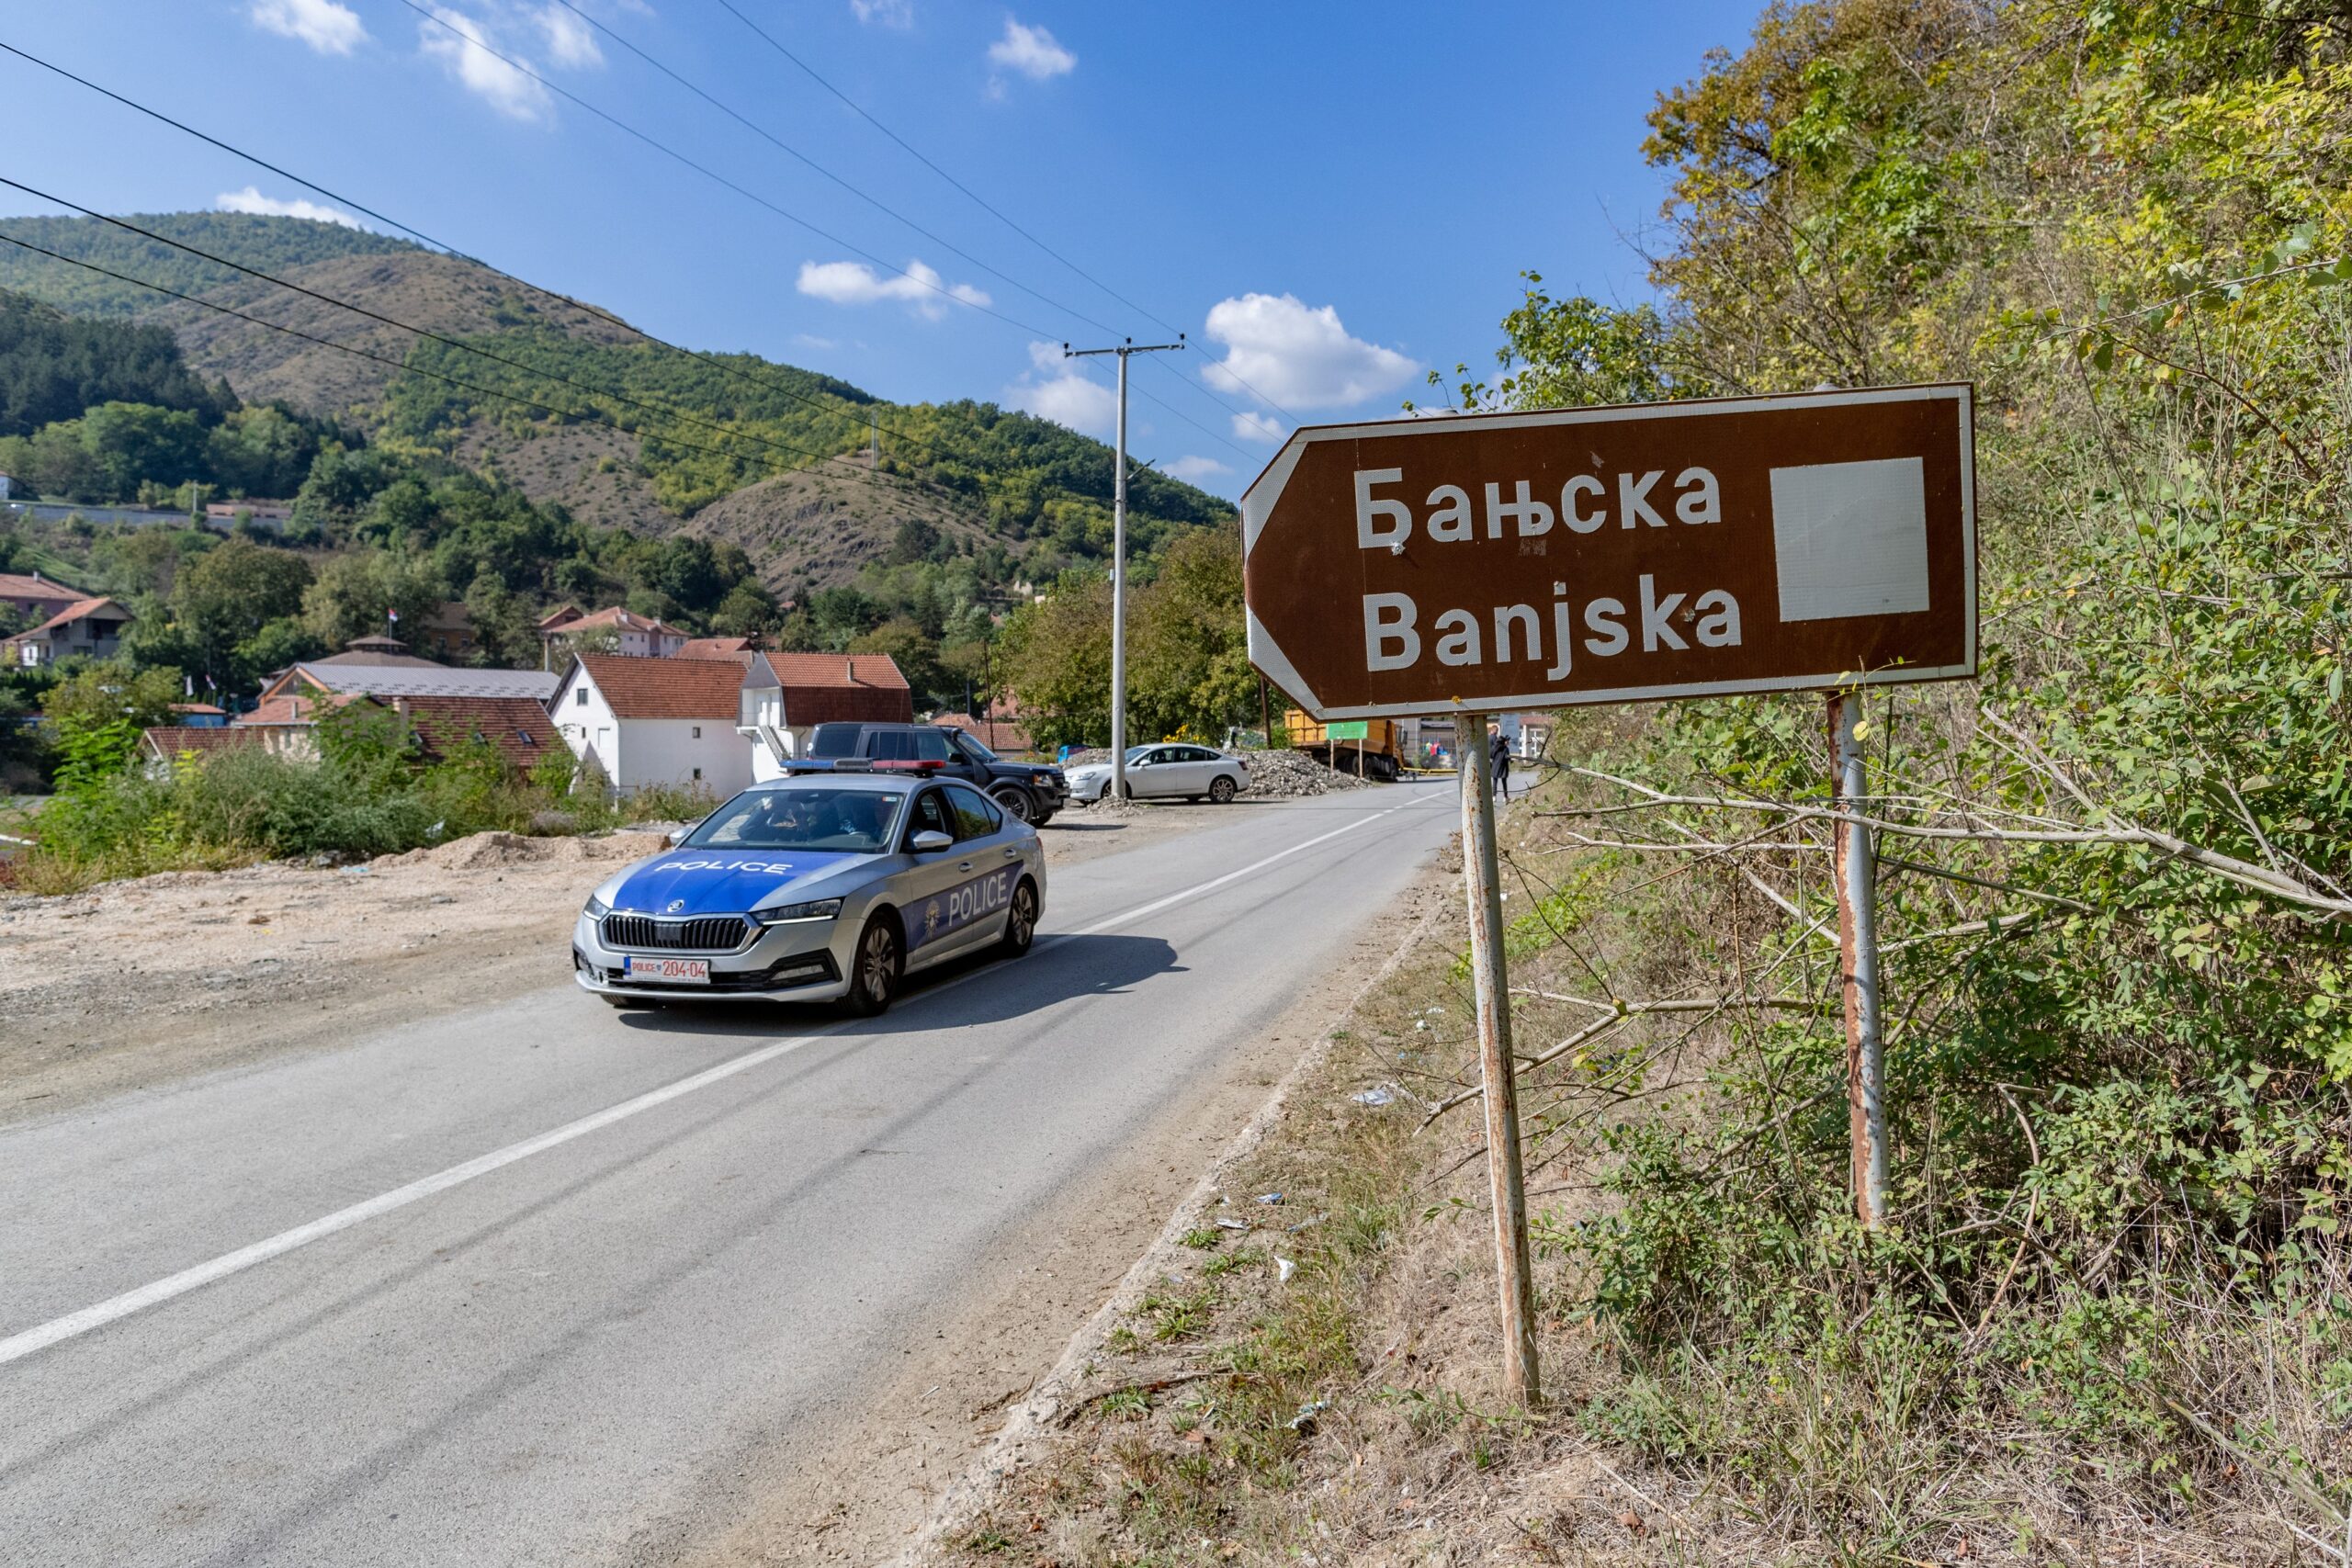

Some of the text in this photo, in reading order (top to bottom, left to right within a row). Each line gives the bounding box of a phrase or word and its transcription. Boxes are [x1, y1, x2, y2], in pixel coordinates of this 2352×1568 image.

[1354, 466, 1723, 549] Бањска
[1363, 573, 1743, 682] Banjska
[654, 860, 794, 874] POLICE
[948, 872, 1008, 927] POLICE
[632, 962, 656, 972] POLICE
